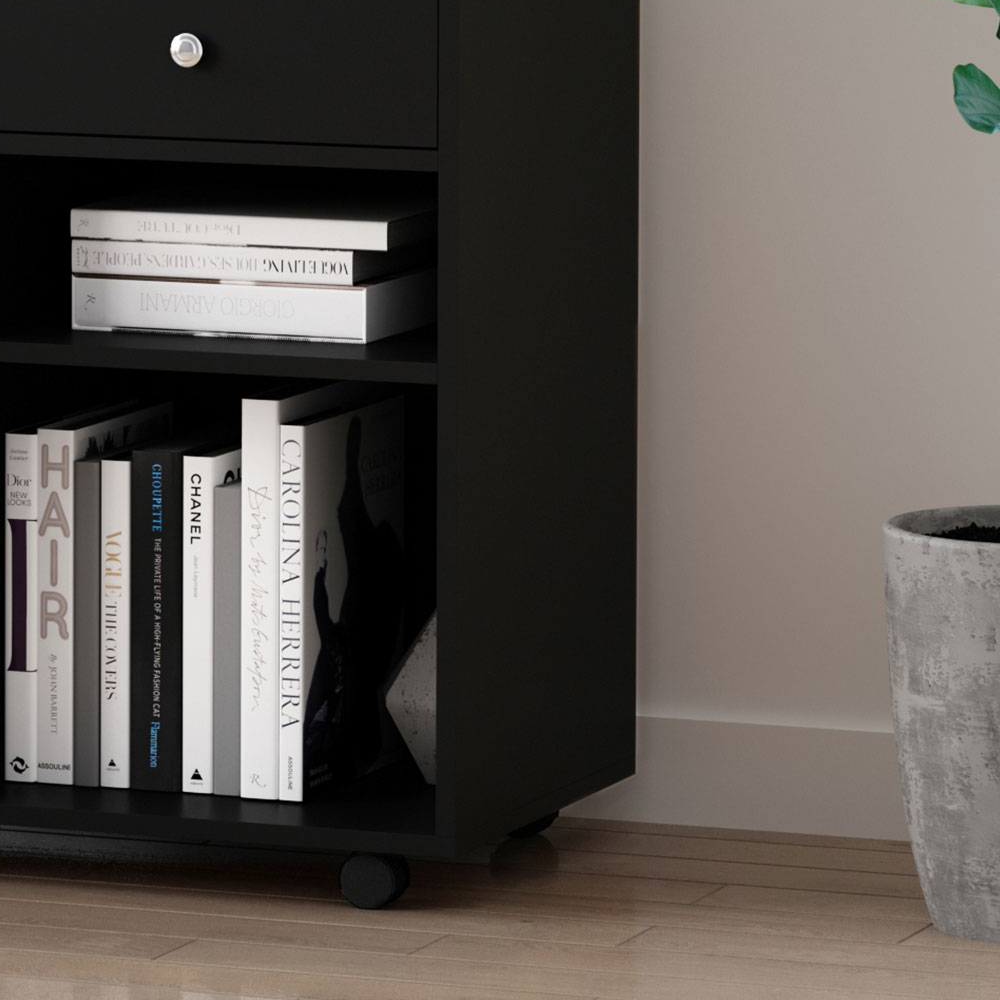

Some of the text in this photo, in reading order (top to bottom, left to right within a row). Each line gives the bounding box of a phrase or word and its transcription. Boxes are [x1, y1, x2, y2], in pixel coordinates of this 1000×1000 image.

[262, 258, 306, 274] LIVING
[308, 259, 349, 276] VOGUE
[140, 291, 296, 319] GIORGIO ARMANI
[6, 473, 33, 487] Dior
[9, 491, 29, 499] NEW
[151, 463, 163, 532] CHOUPETTE
[190, 473, 202, 545] CHANEL
[39, 443, 70, 640] HAIR
[153, 538, 162, 552] THE
[153, 553, 162, 583] PRIVATE
[153, 585, 162, 601] LIFE
[282, 439, 301, 728] CAROLINA HERRERA
[104, 530, 122, 700] VOGUE THE COVERS
[153, 602, 162, 613] OF
[153, 622, 162, 669] HIGH-FLYING
[48, 665, 57, 692] JOHN
[152, 669, 161, 701] FASHION
[50, 694, 58, 735] BARRETT
[152, 703, 161, 718] CAT
[149, 721, 161, 768] Flammarion
[37, 762, 71, 771] ASSOULINE
